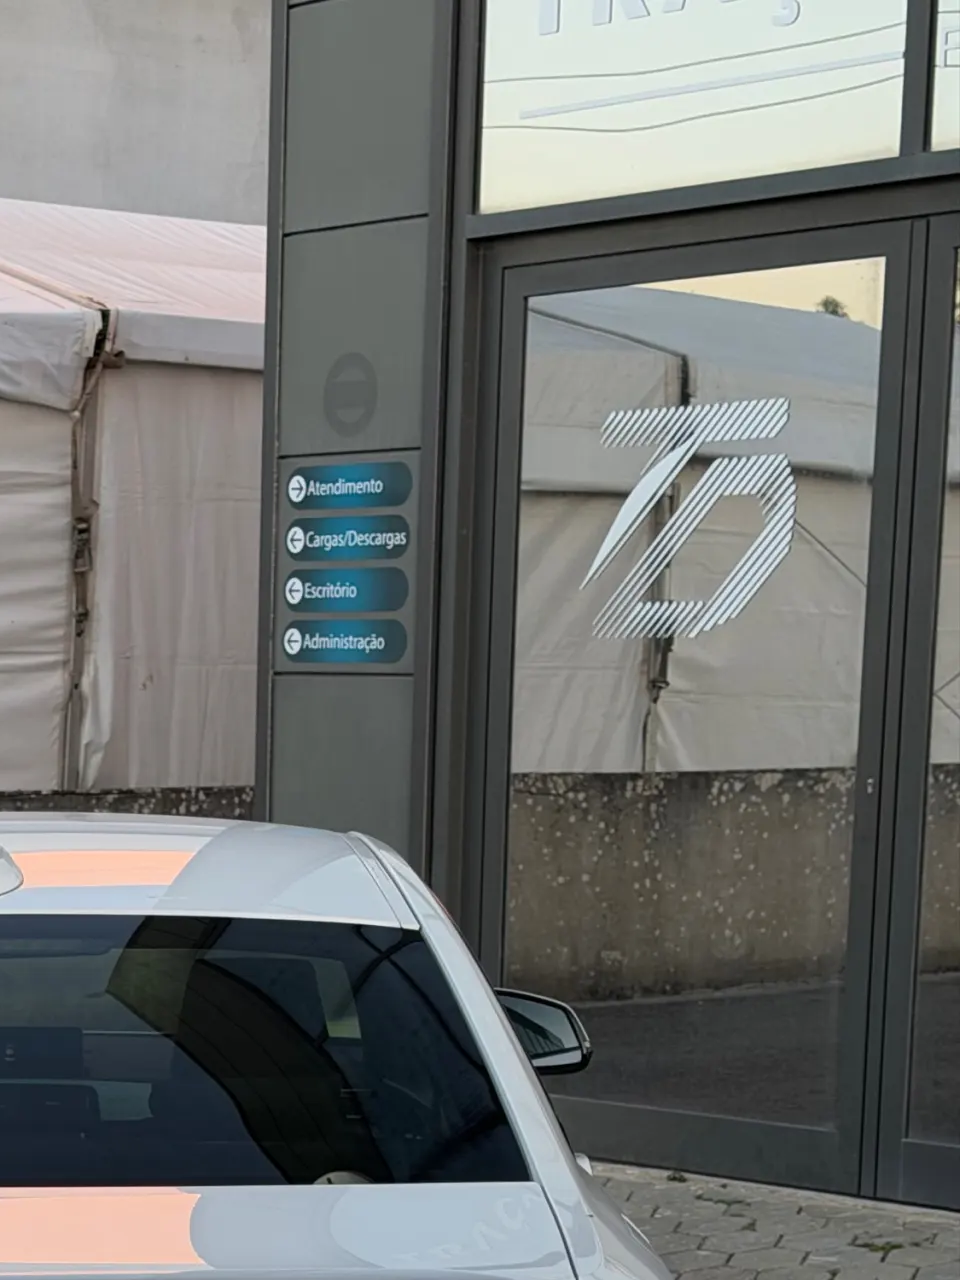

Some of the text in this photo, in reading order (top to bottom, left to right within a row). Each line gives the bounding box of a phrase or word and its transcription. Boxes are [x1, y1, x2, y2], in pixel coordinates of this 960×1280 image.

[307, 478, 384, 496] Atendimento
[305, 529, 407, 551] Cargas/Descargas
[304, 582, 357, 599] Escritório
[303, 633, 385, 654] Administração
